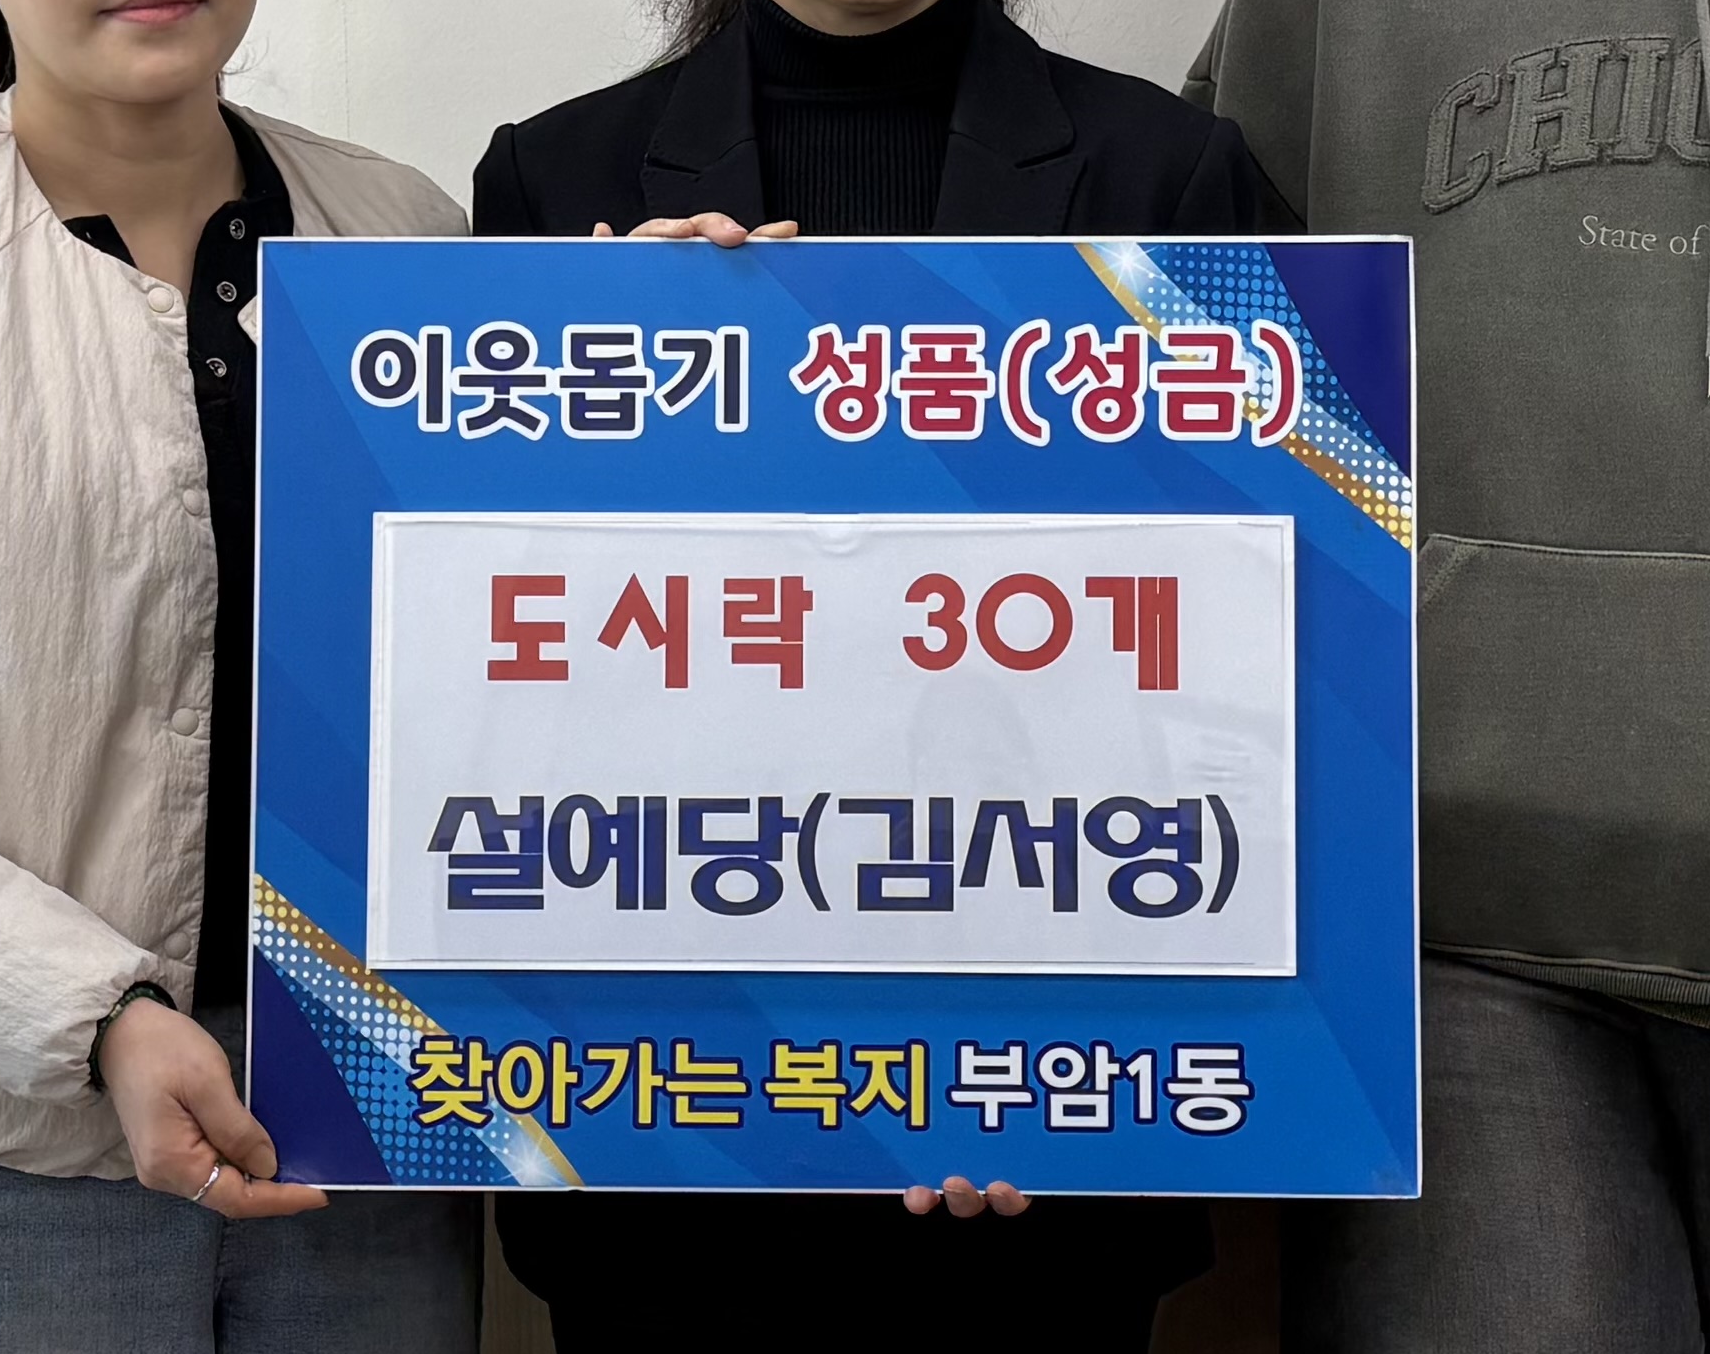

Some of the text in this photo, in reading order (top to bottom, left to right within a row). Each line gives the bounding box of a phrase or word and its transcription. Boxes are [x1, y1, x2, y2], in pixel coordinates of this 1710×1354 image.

[1578, 215, 1657, 251] State
[355, 322, 1303, 443] 이웃돕기 성품(성금)
[486, 571, 1180, 692] 도시락 30개
[426, 791, 1241, 918] 설예당(김서영)
[411, 1038, 1251, 1132] 찾아가는 복지 부암1동
